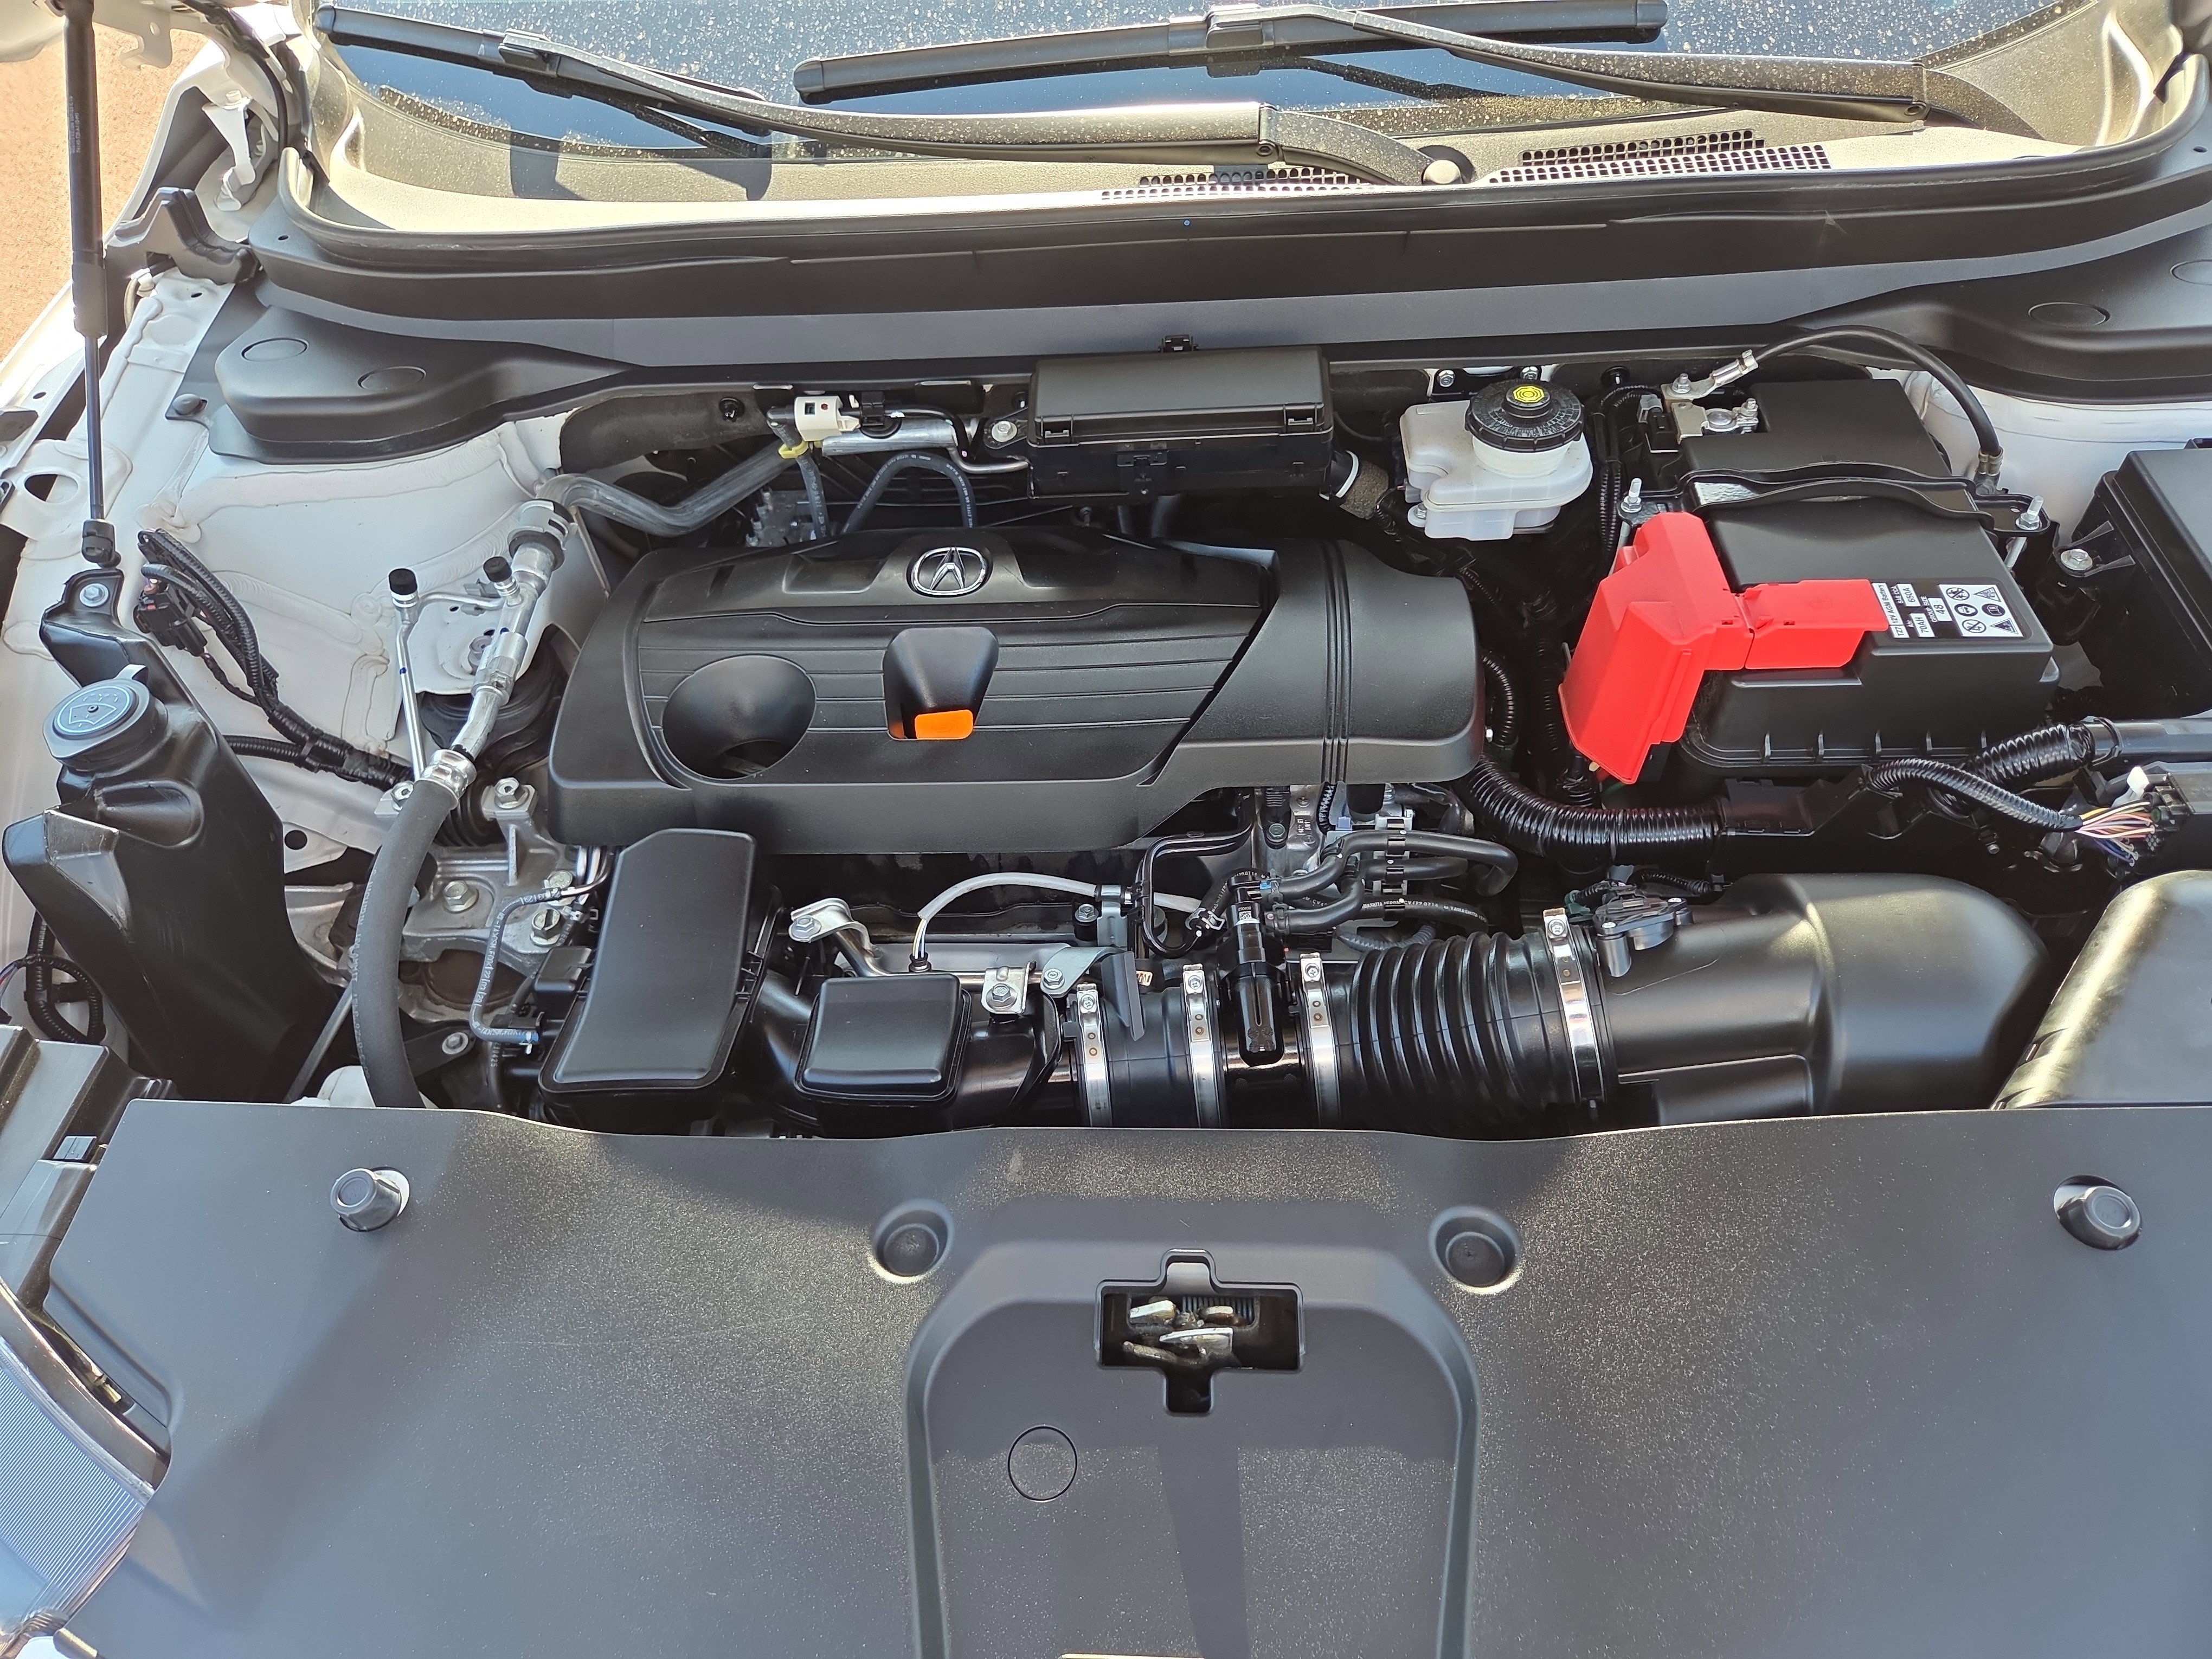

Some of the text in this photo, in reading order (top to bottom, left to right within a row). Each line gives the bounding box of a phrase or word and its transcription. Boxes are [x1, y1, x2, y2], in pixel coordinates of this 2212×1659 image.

[1902, 587, 1916, 603] 650A
[1877, 584, 1899, 623] 12V AGM Battery
[1933, 605, 1946, 614] 48
[1894, 626, 1905, 636] TZ7
[1914, 617, 1930, 633] 70AH
